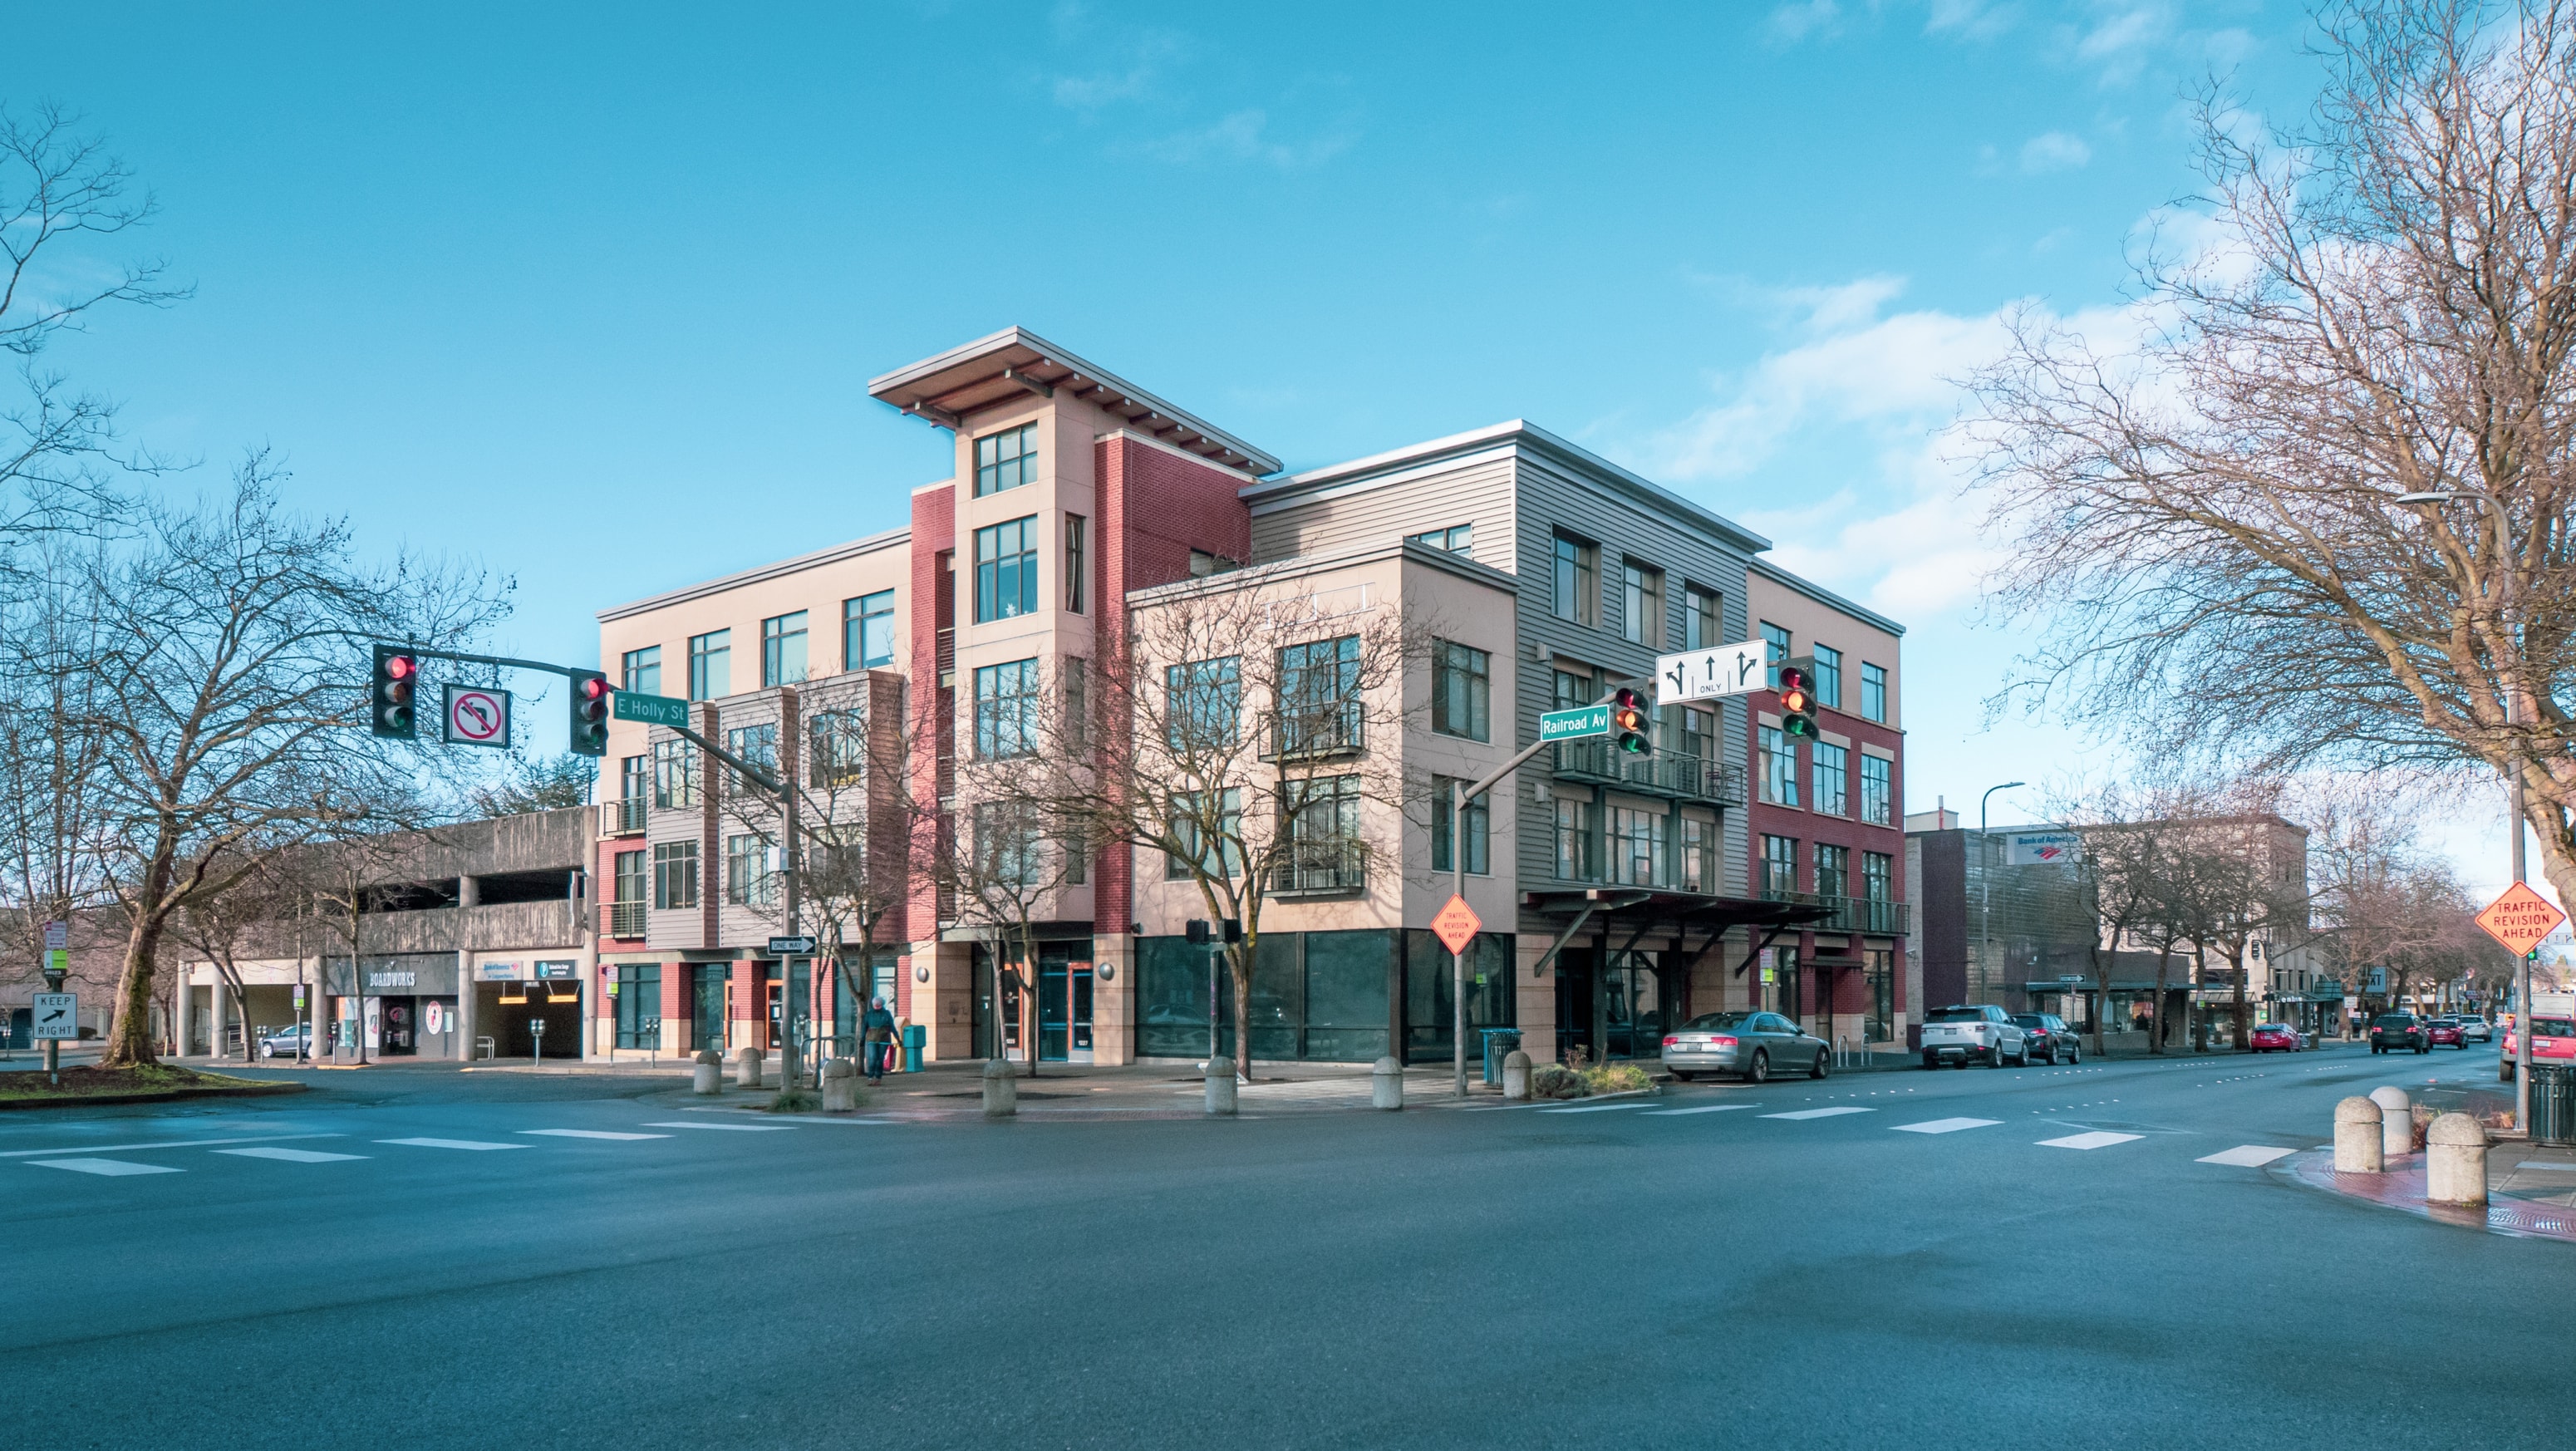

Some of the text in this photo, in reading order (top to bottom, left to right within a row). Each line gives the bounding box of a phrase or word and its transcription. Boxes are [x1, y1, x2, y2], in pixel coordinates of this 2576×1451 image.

[1700, 683, 1722, 693] ONLY
[618, 698, 684, 721] E Holly St
[1543, 713, 1606, 735] Railroad Av
[2498, 901, 2546, 913] TRAFFIC
[2494, 914, 2550, 927] REVISION
[2502, 927, 2543, 939] AHEAD
[369, 971, 415, 987] BOARDWORKS
[41, 996, 71, 1006] KEEP
[38, 1026, 71, 1035] RIGHT
